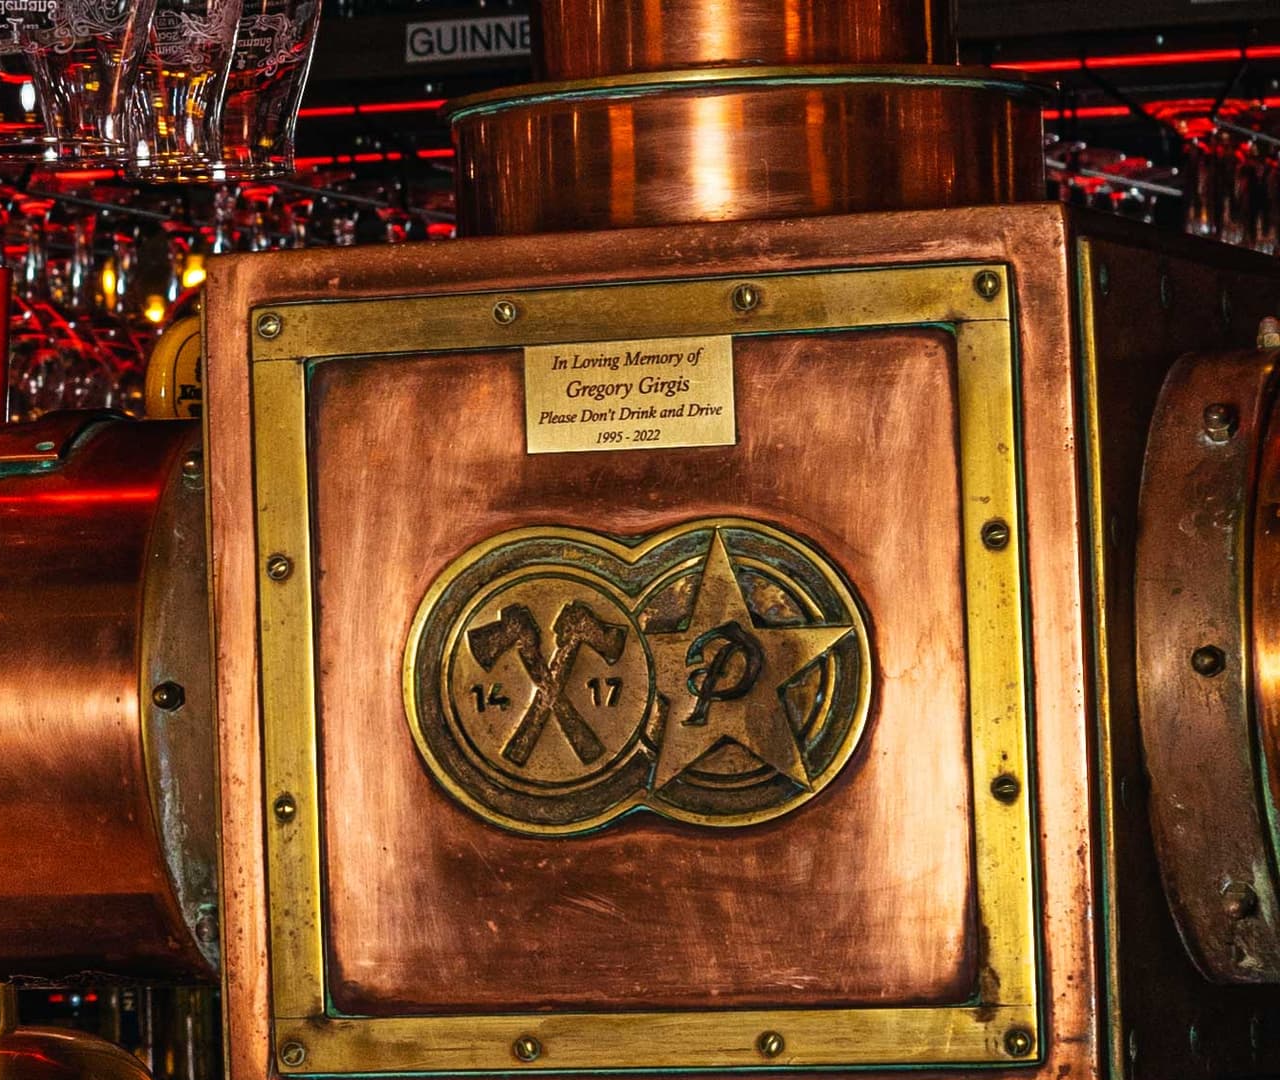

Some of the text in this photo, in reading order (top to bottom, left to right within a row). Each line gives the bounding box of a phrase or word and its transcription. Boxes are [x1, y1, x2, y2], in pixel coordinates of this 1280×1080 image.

[551, 347, 704, 370] In Loving Memory of
[566, 375, 690, 400] Gregory Girgis
[538, 402, 723, 425] Please Don't Drink and Drive
[595, 430, 623, 444] 1995
[632, 429, 661, 442] 2022
[469, 676, 624, 714] 14 17
